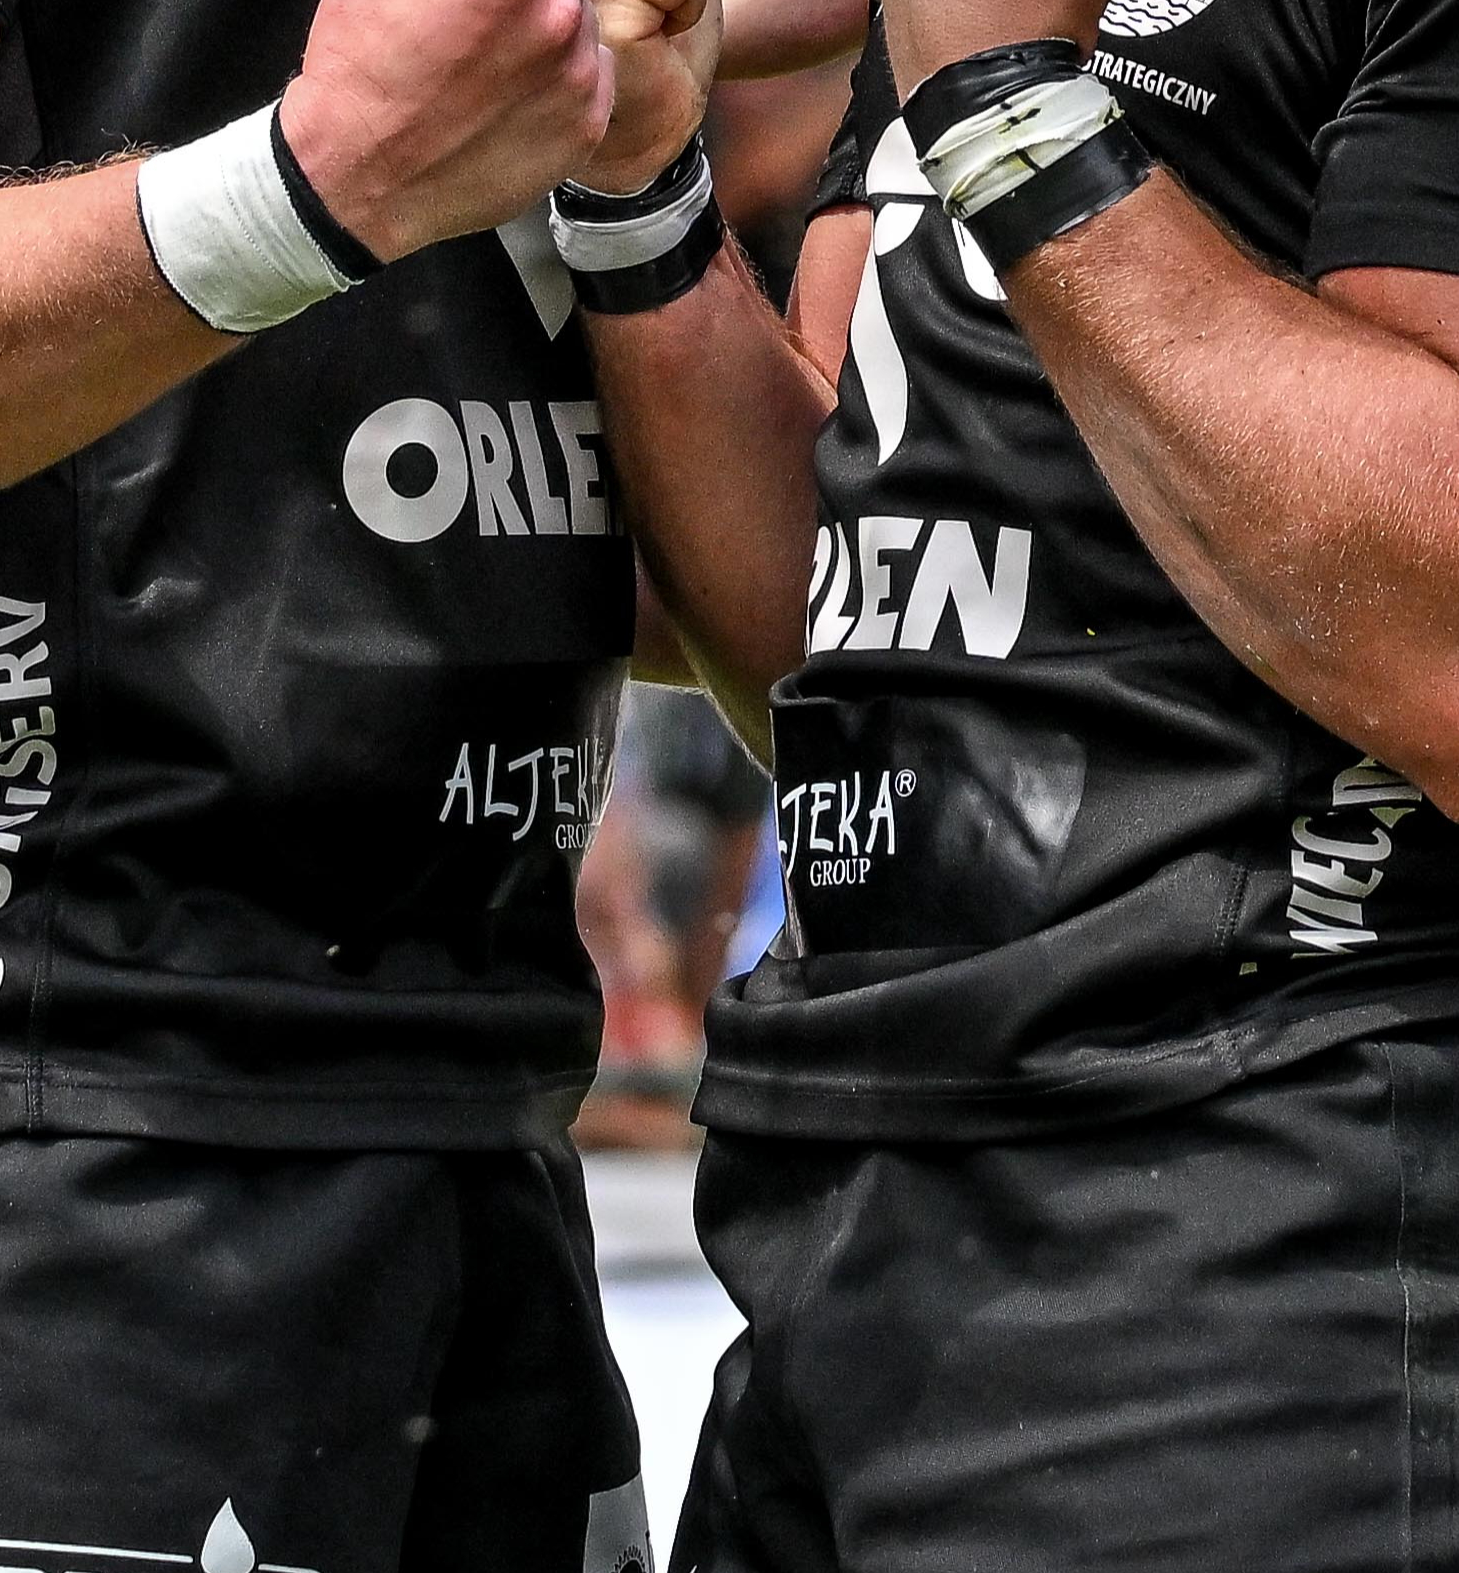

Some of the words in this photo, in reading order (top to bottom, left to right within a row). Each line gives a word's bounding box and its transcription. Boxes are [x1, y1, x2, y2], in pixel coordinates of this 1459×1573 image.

[342, 398, 613, 543] ORLE
[803, 515, 1032, 660] LEN
[809, 857, 871, 887] GROUP
